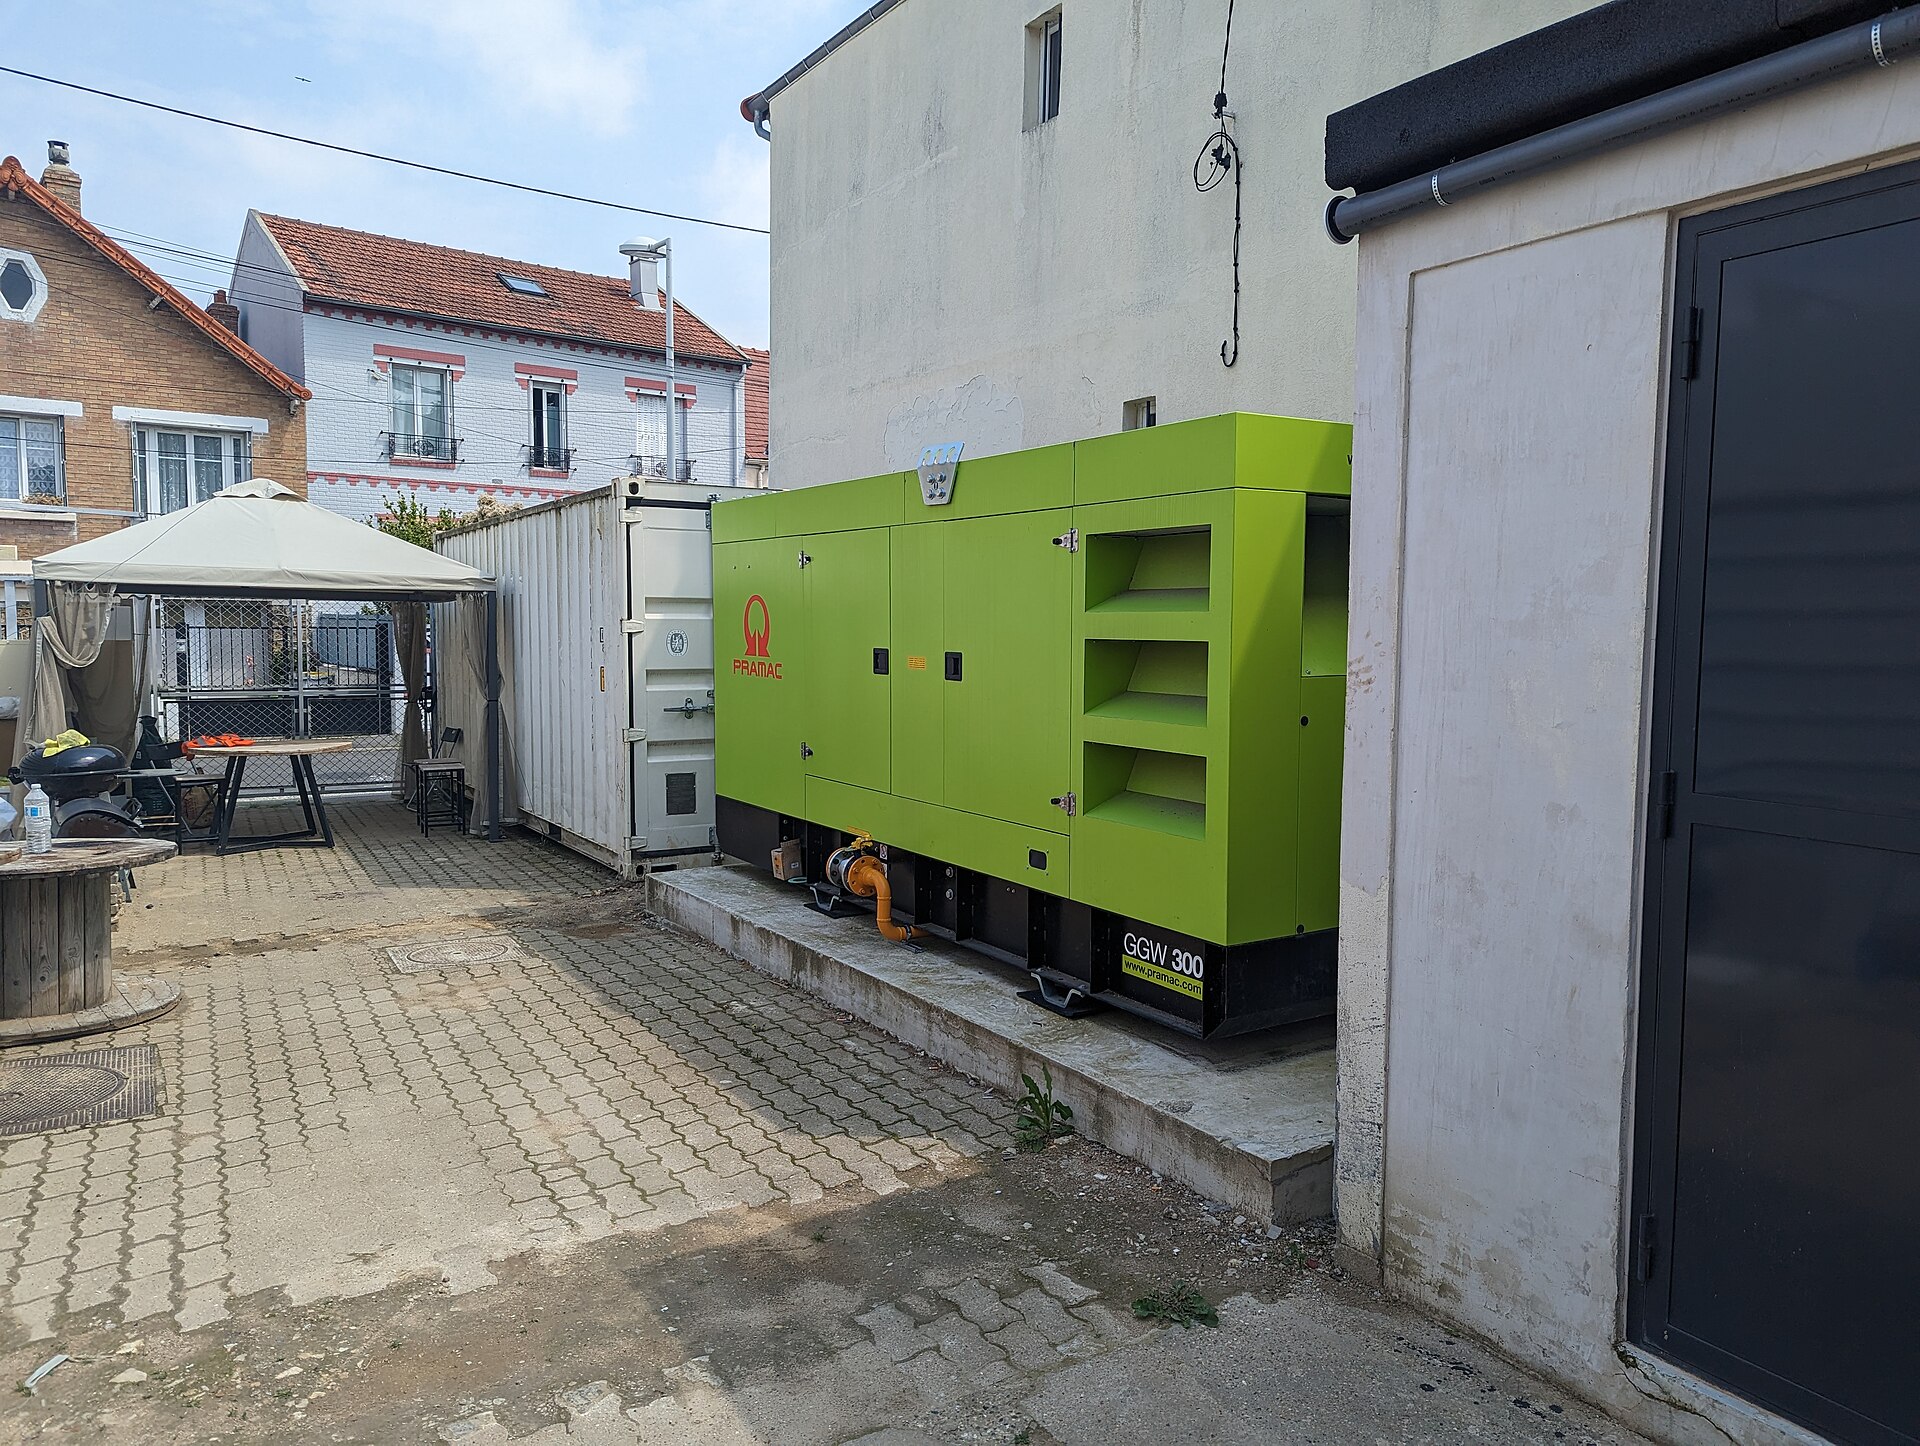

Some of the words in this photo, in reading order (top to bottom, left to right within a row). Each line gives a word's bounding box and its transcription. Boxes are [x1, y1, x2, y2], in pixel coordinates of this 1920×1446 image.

[733, 659, 782, 679] PRAMAC
[1123, 932, 1168, 966] GGW
[1171, 948, 1204, 979] 300
[1124, 959, 1202, 995] www.pramac.com
